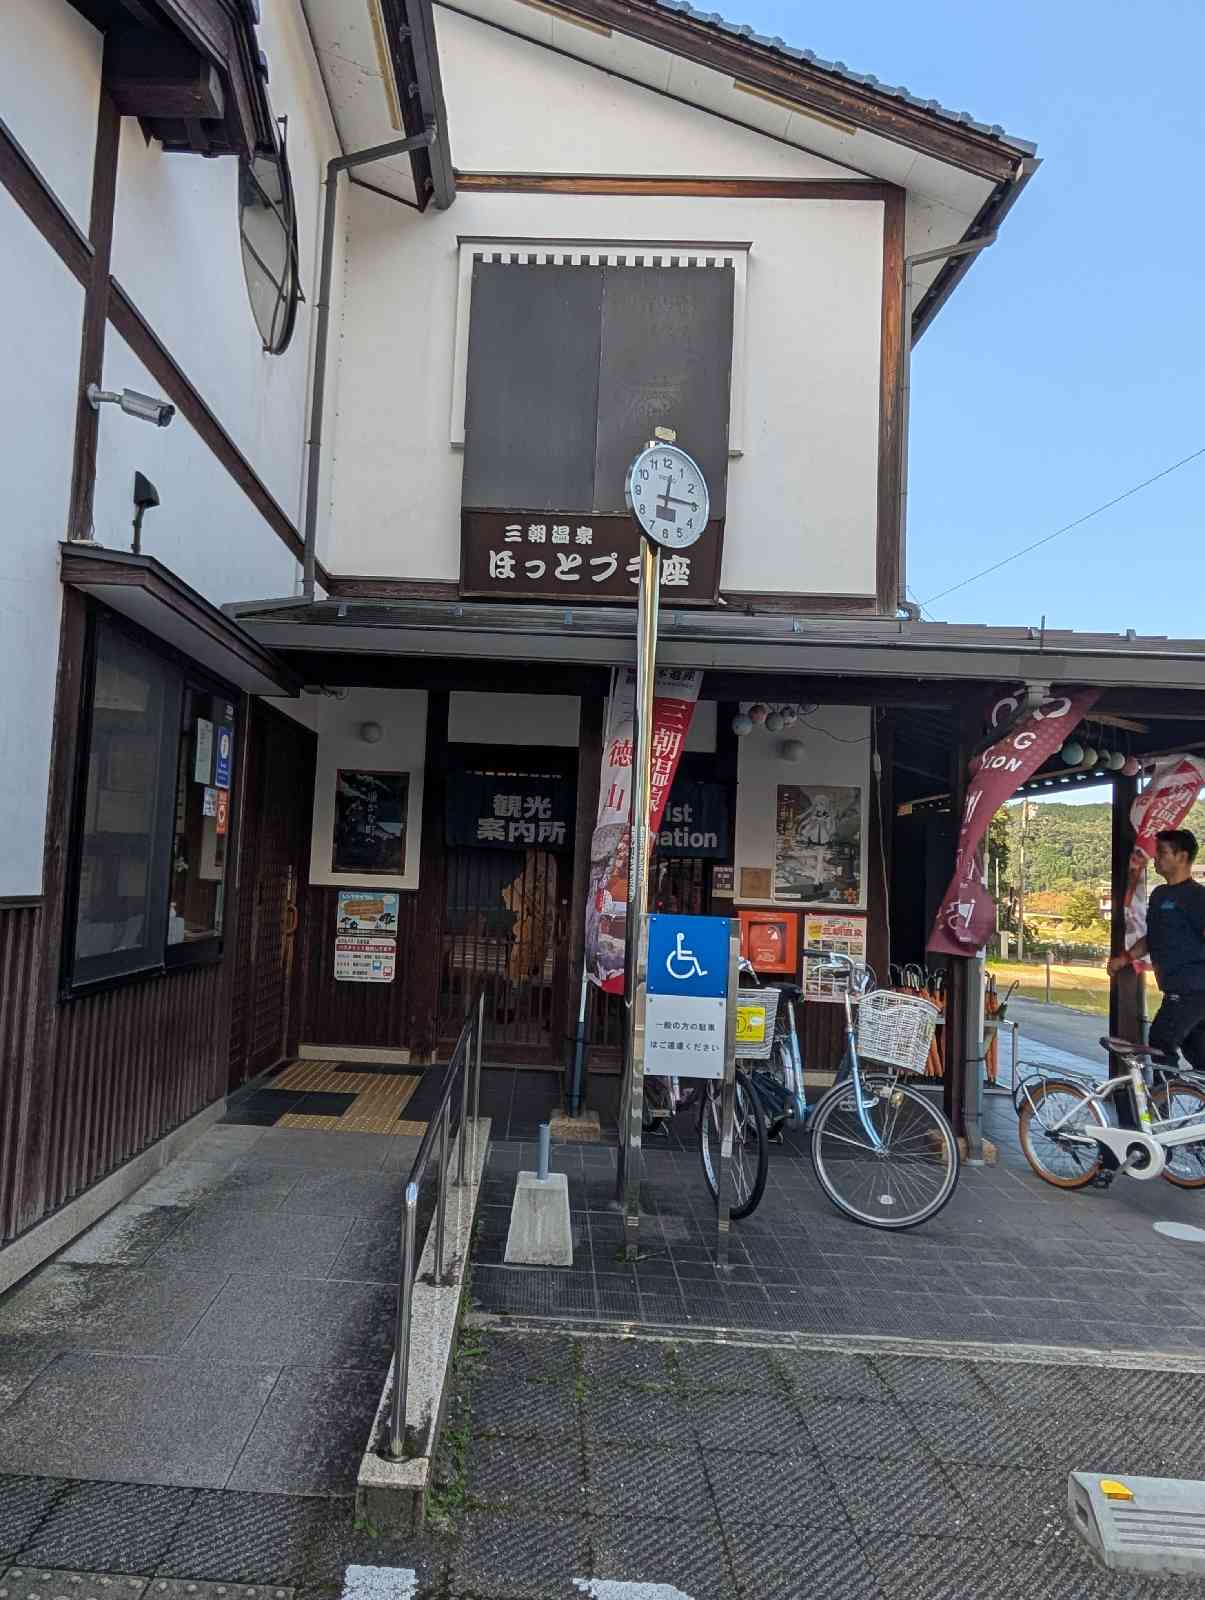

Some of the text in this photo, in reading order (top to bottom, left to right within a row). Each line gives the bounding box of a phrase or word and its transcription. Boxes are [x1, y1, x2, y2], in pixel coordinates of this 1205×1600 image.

[649, 456, 658, 470] 11
[663, 457, 673, 469] 12
[640, 468, 649, 480] 10
[680, 468, 684, 478] 1
[635, 484, 642, 495] 9
[688, 483, 695, 494] 2
[639, 504, 646, 515] 8
[649, 520, 656, 530] 7
[686, 518, 693, 529] 4
[504, 524, 593, 545] 三朝温泉
[663, 529, 669, 539] 6
[677, 527, 684, 538] 5
[493, 793, 552, 818] 観光
[477, 817, 567, 846] 案内所
[655, 1021, 716, 1032] 一般の方の駐車
[650, 1040, 720, 1052] はご遠慮ください
